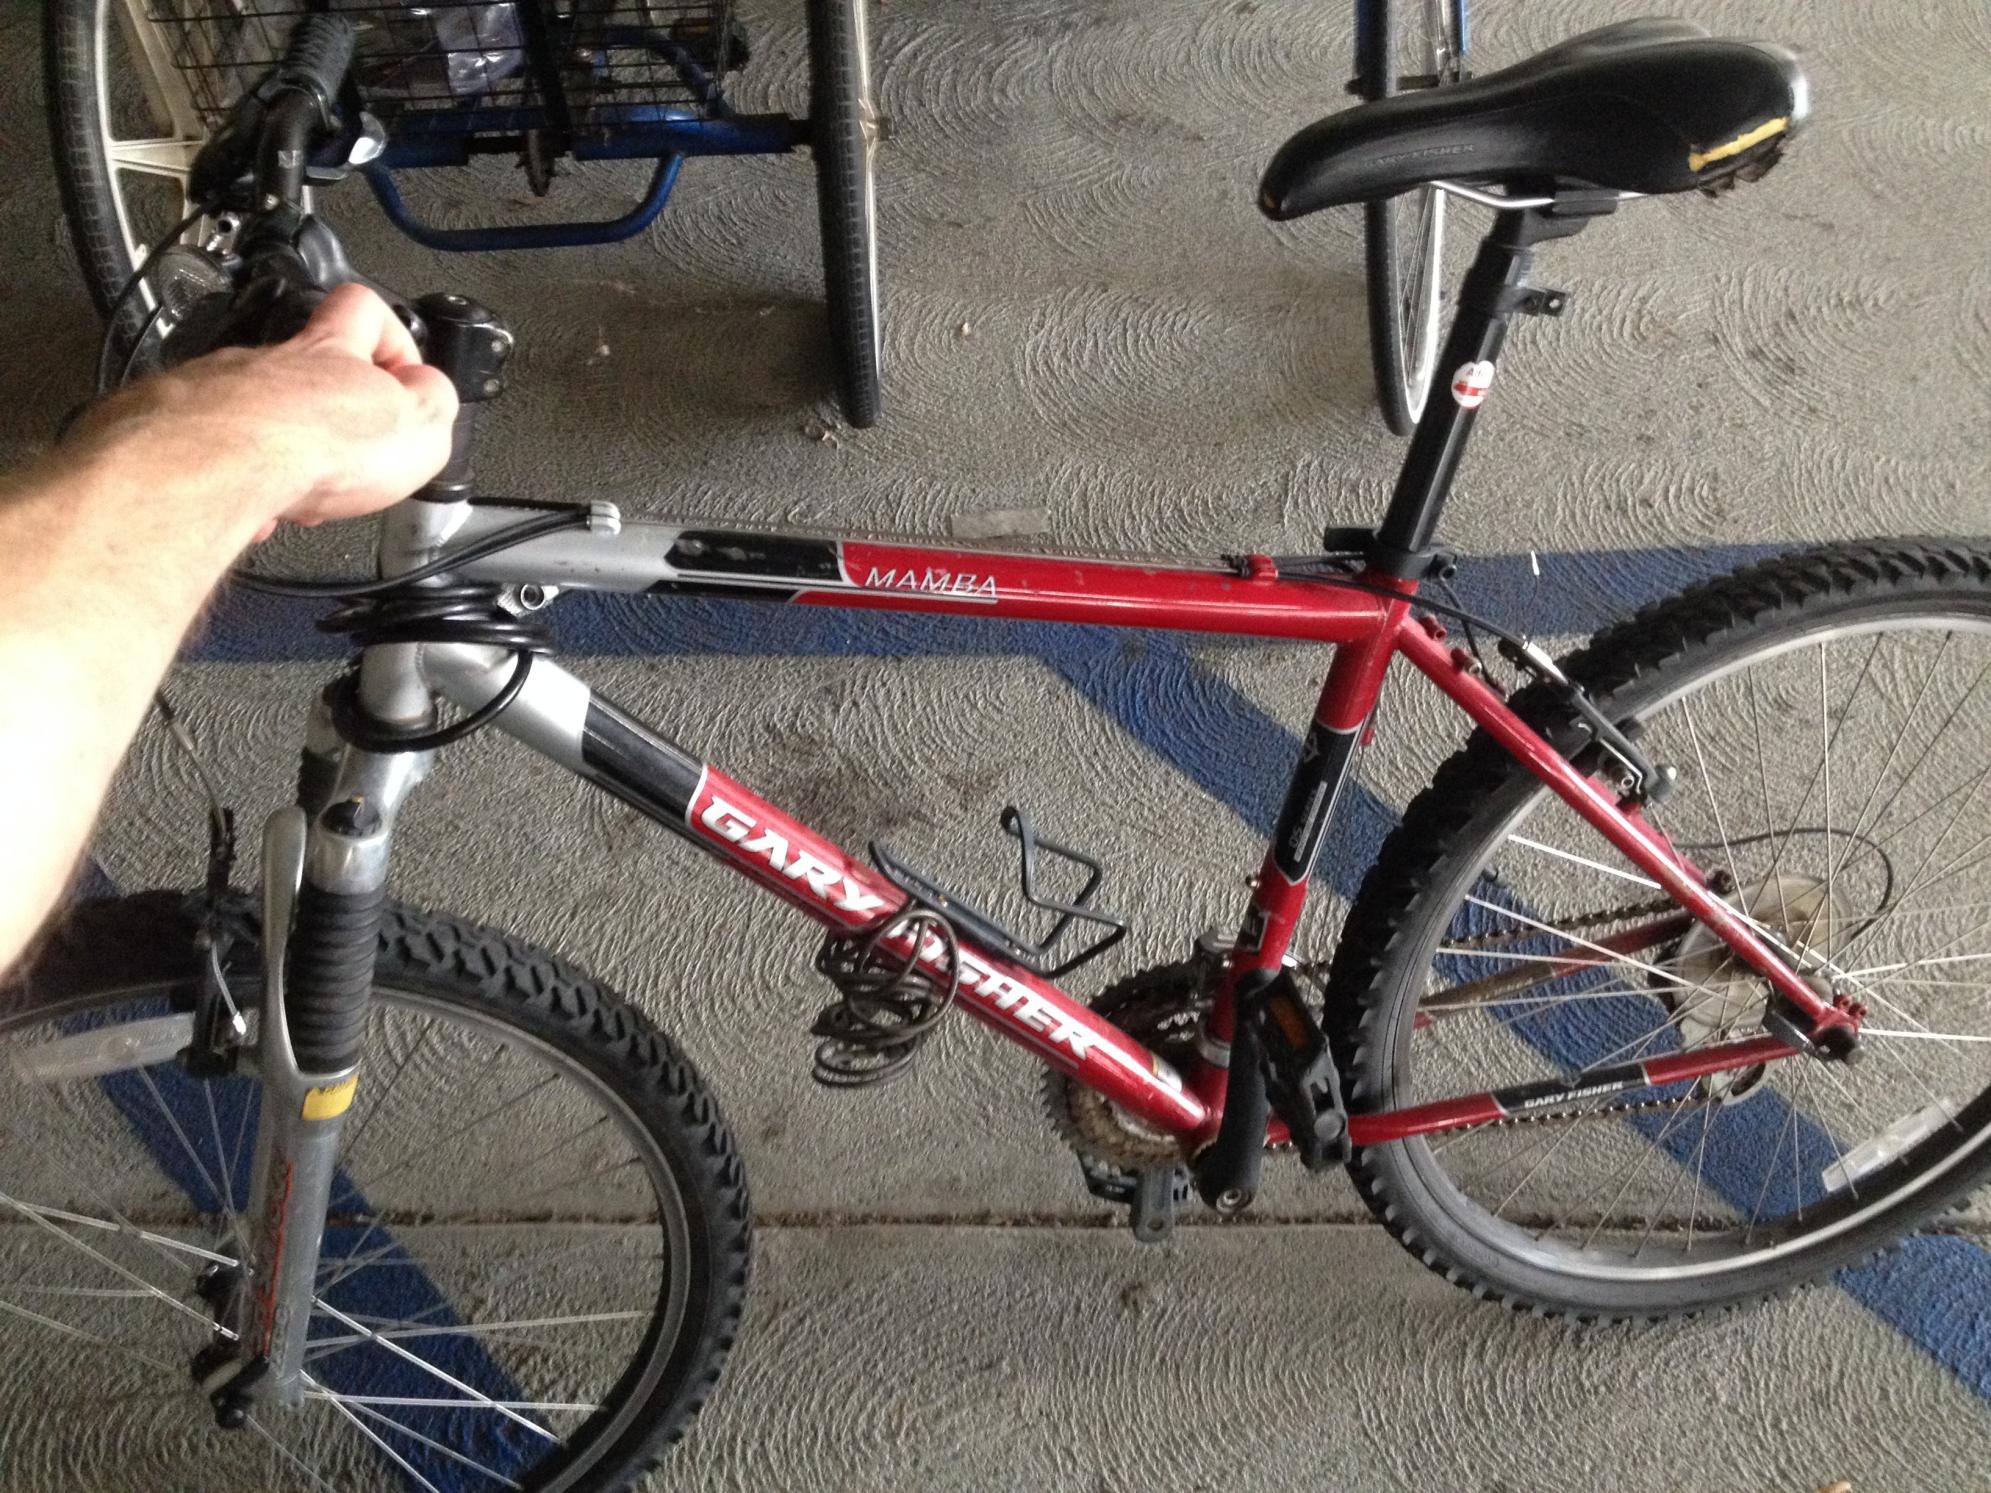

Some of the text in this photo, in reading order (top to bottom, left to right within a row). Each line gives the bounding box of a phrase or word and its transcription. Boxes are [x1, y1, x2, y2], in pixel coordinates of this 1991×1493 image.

[863, 566, 998, 597] MAMBA
[701, 795, 885, 911] GARY
[1524, 1081, 1623, 1108] GARY FISHER
